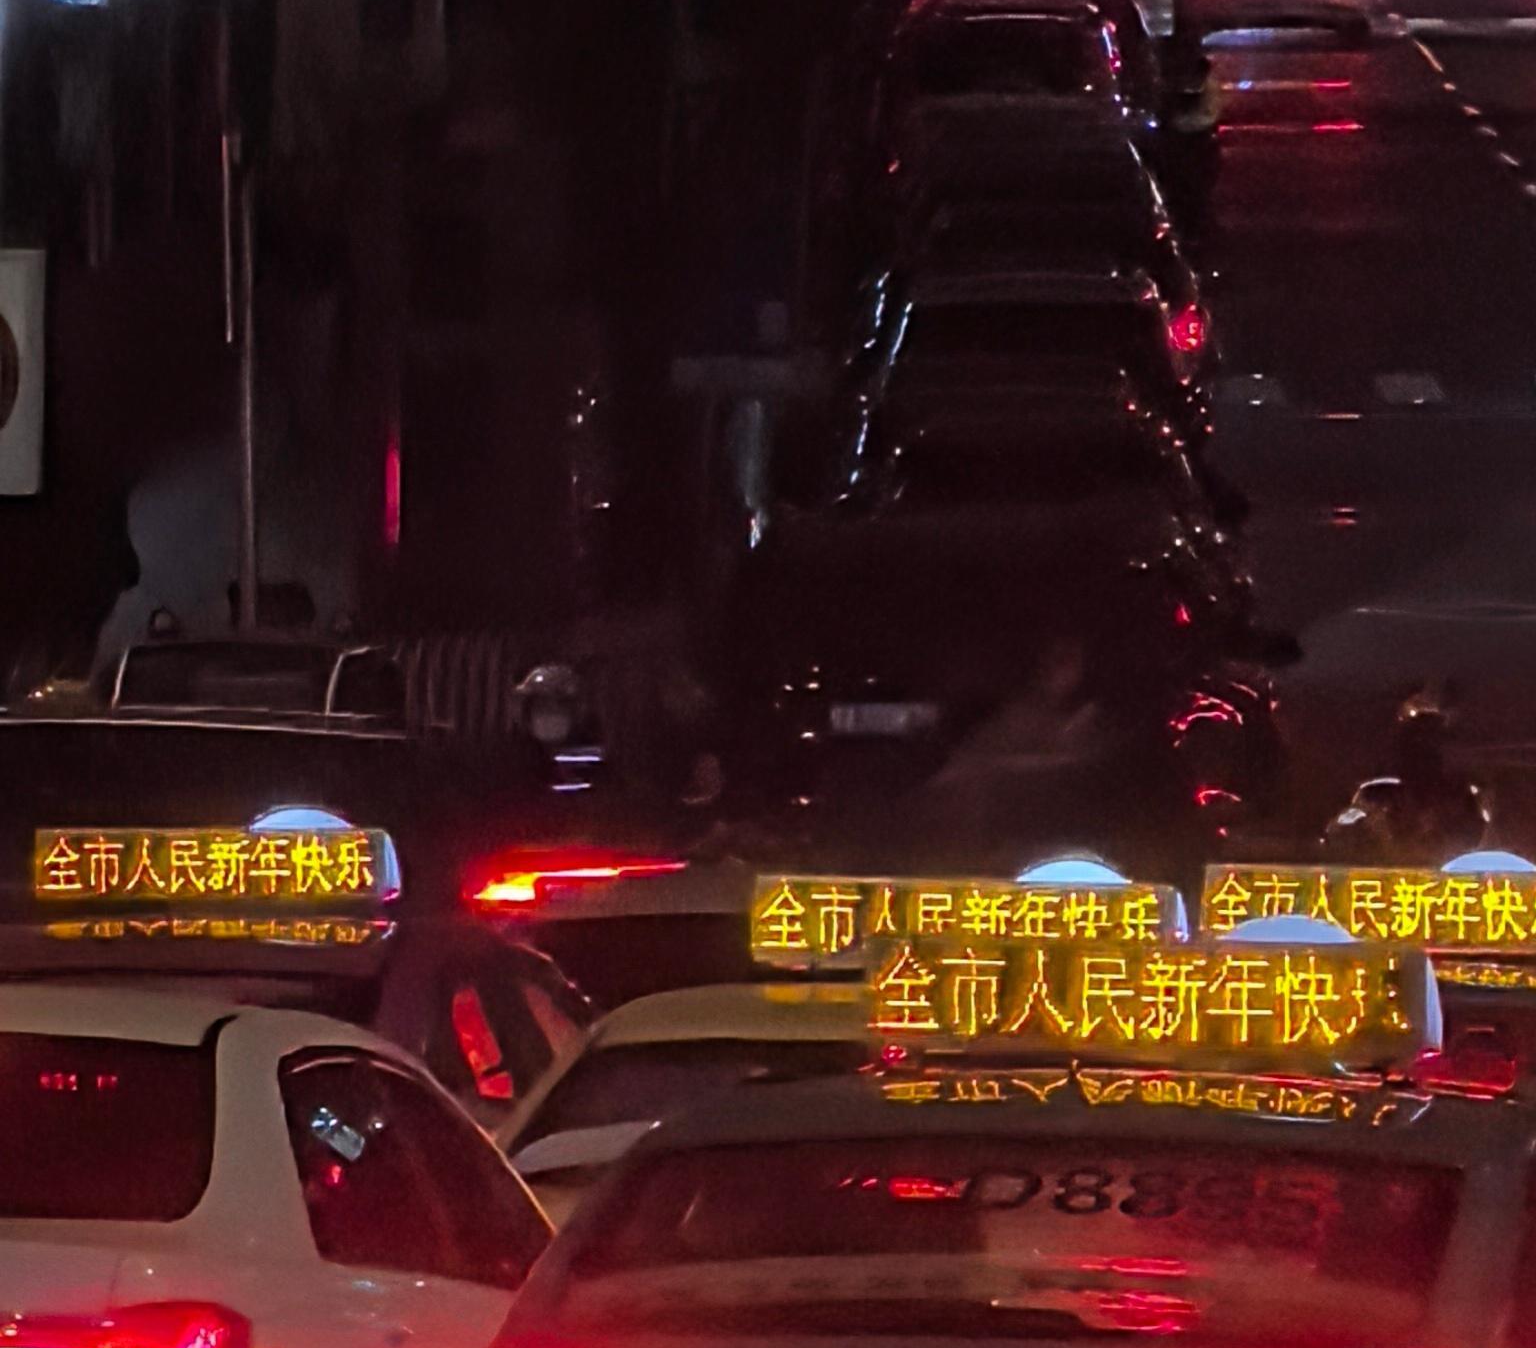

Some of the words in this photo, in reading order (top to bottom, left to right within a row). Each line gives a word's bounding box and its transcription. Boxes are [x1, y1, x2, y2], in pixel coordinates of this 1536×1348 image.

[43, 835, 374, 894] 全市人民新年快乐
[751, 878, 1164, 953] 全市人民新年快乐
